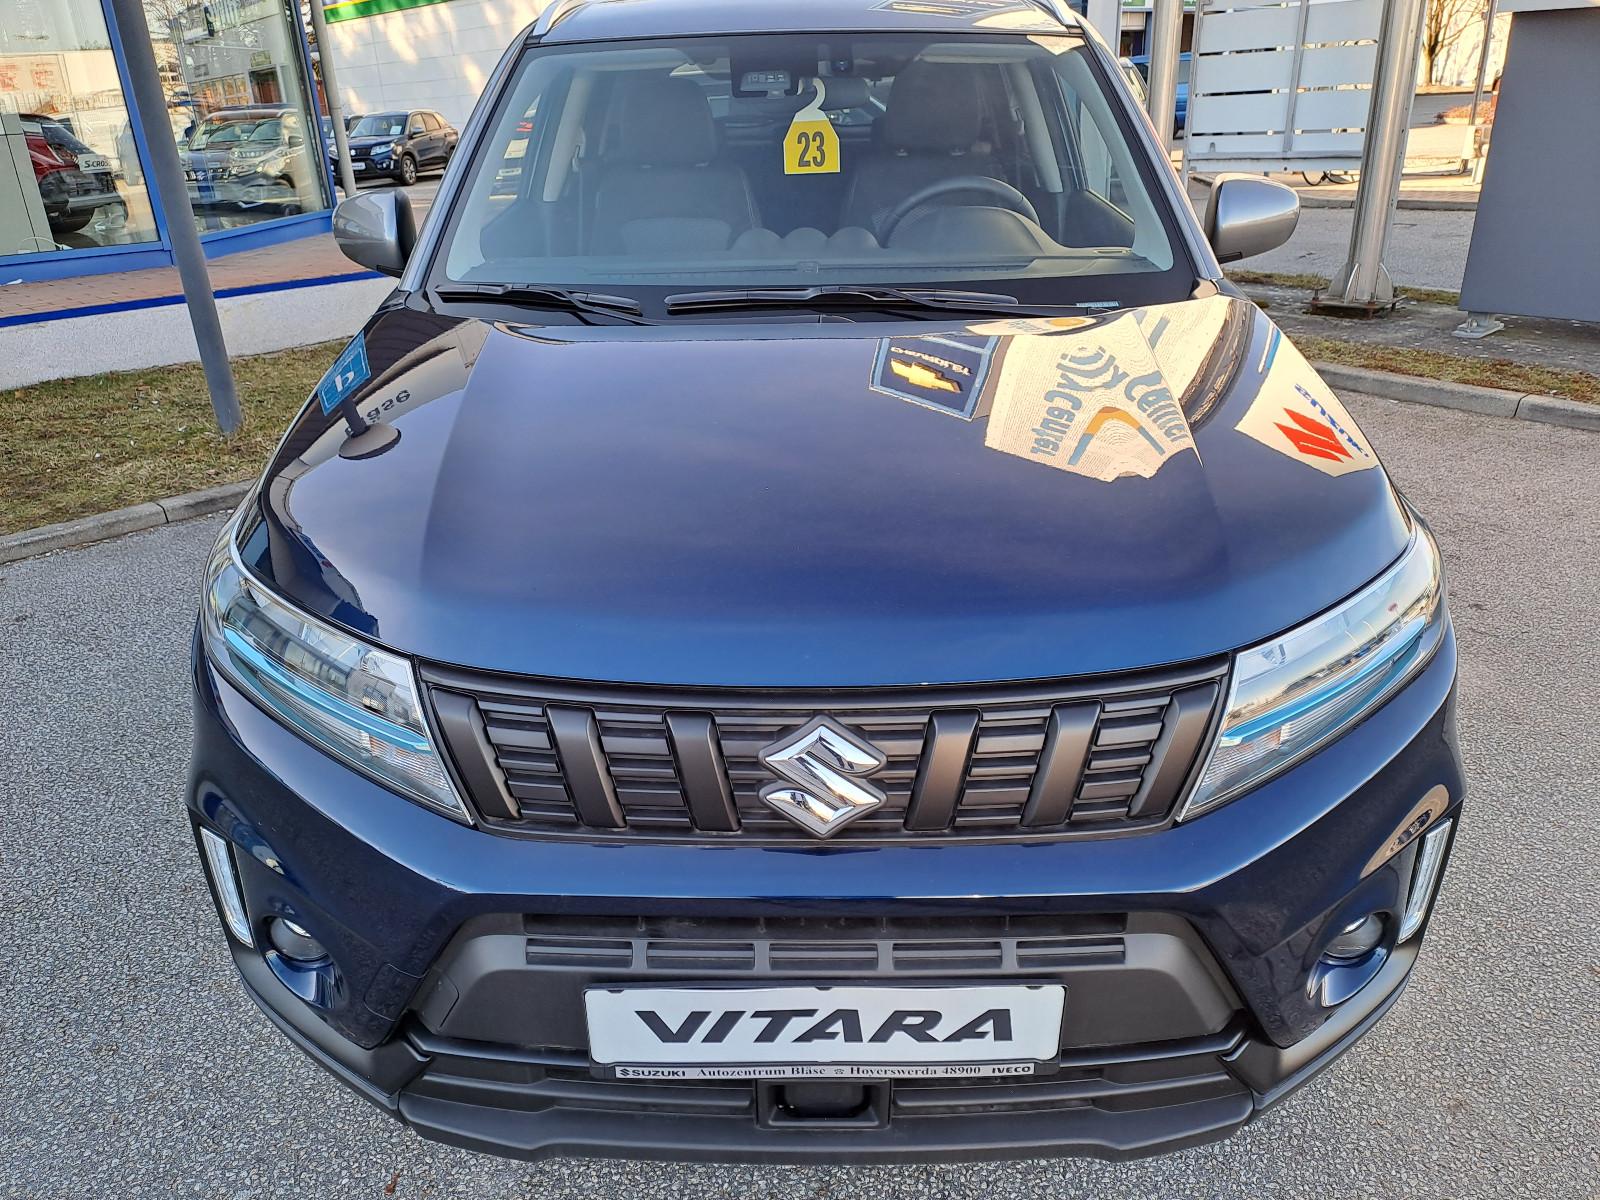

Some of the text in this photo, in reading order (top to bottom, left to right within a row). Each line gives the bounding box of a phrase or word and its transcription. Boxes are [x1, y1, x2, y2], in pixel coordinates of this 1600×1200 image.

[797, 131, 826, 167] 23
[634, 1008, 1014, 1043] VITARA
[631, 1065, 1031, 1077] SUZUKI Autozentrum Bläse Hoyerswerda 48900 IVECO
